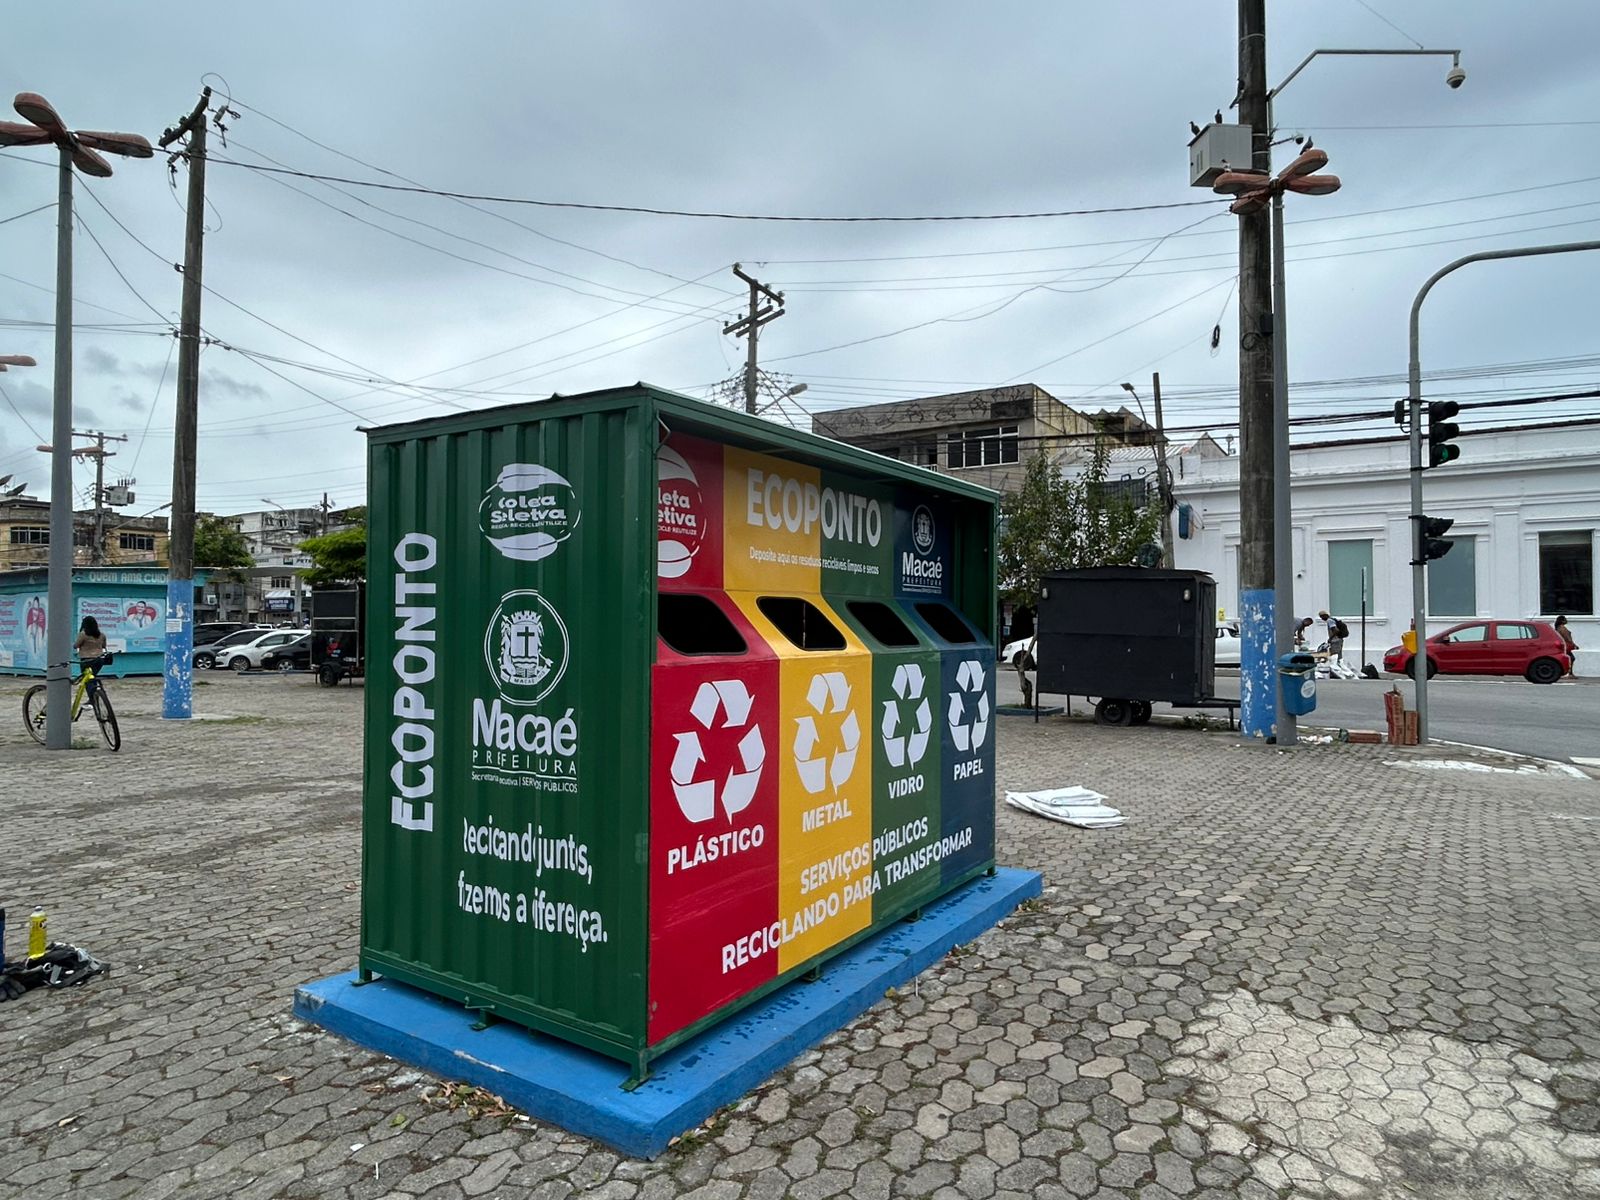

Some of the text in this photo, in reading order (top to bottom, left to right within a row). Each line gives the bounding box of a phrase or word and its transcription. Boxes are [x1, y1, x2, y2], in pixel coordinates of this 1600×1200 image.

[747, 467, 882, 547] ECOPONTO
[749, 546, 776, 563] Deposite
[777, 551, 790, 566] aqui
[791, 556, 798, 565] os
[847, 559, 862, 574] limpos
[866, 565, 880, 575] secos
[902, 551, 942, 579] Macaé
[902, 576, 942, 586] PREFEITURA
[391, 532, 436, 832] ECOPONTO
[473, 697, 578, 757] Macaé
[953, 758, 984, 781] PAPEL
[543, 780, 578, 793] PÚBLICOS
[888, 774, 924, 799] VIDRO
[802, 798, 852, 833] METAL
[667, 824, 765, 875] PLÁSTICO
[800, 816, 929, 895] SERVIÇOS PÚBLICOS
[515, 893, 527, 924] a
[721, 826, 973, 975] RECICLANDO PARA TRANSFORMAR
